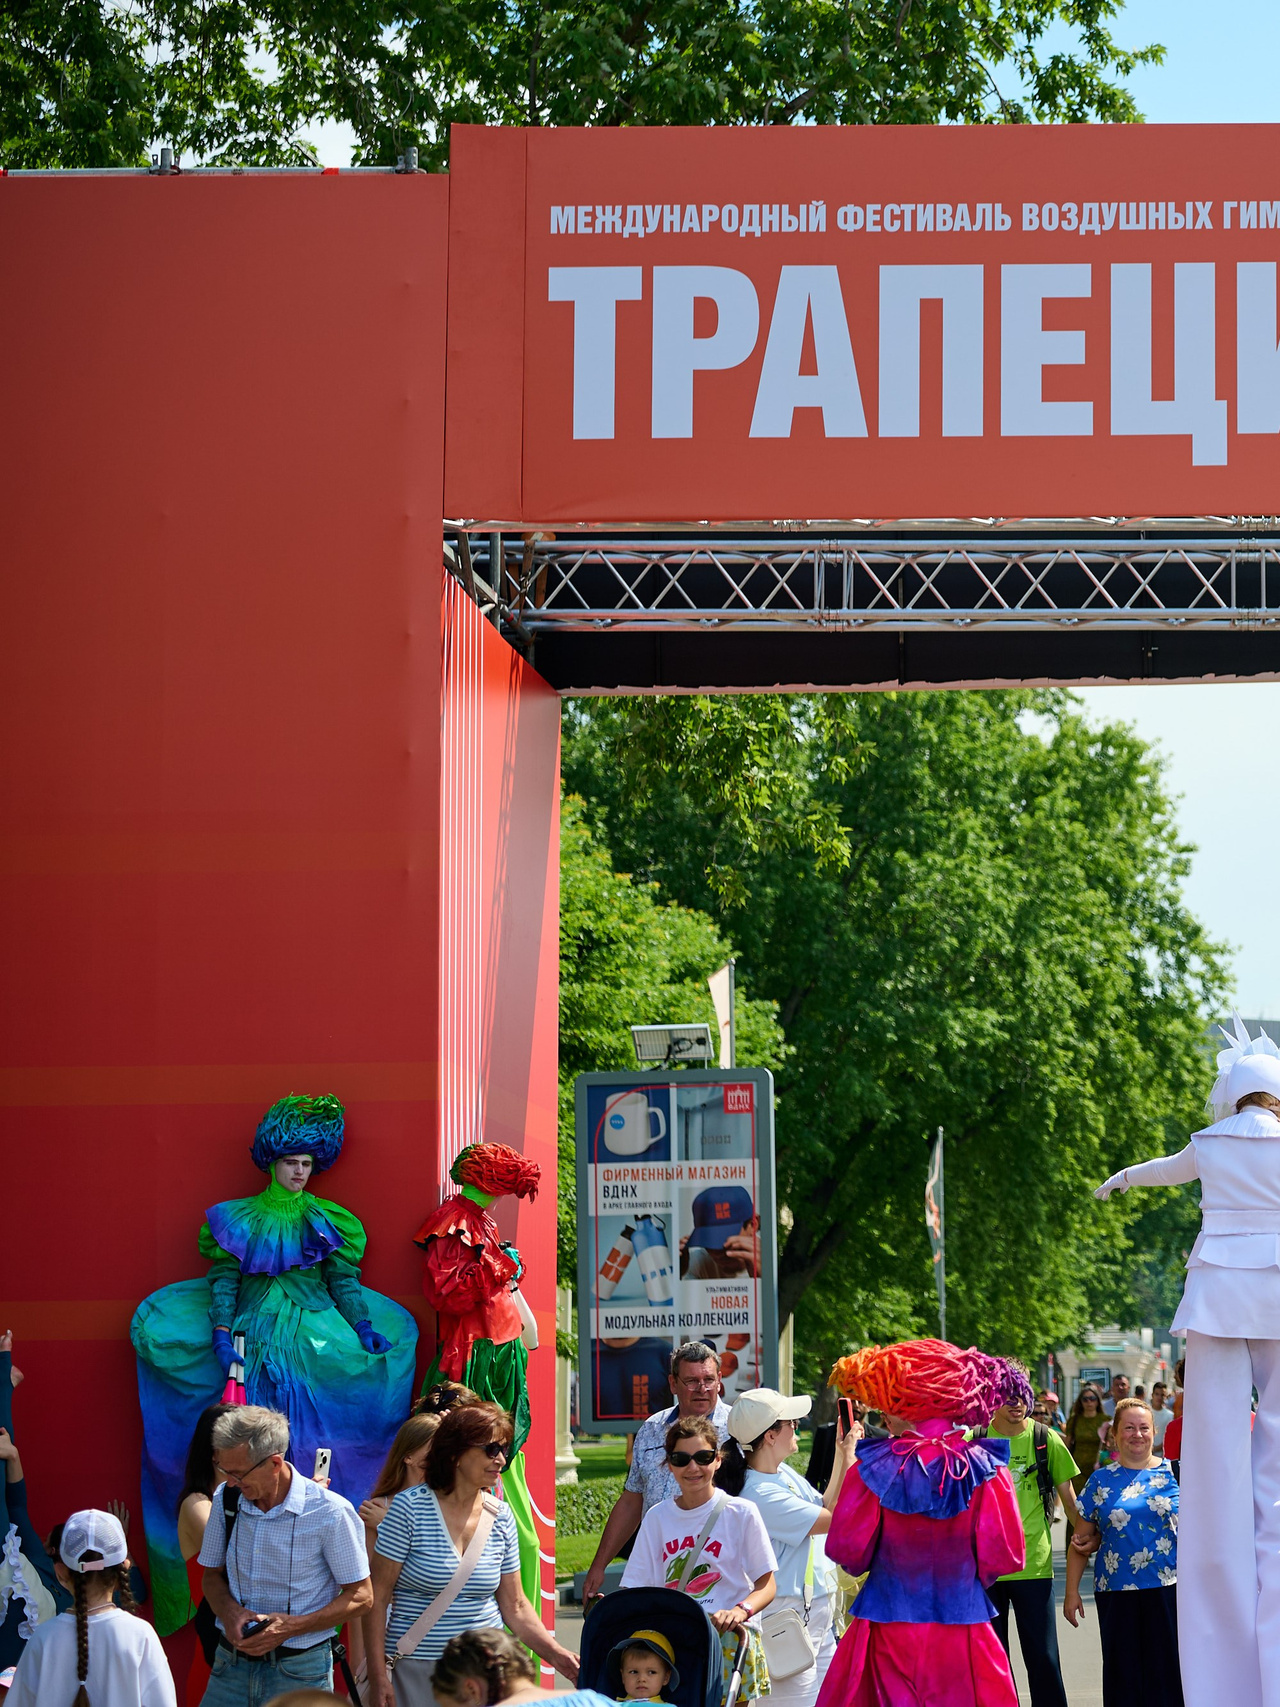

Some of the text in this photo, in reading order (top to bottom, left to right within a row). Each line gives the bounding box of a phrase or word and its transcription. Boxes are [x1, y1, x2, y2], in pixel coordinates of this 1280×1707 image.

[550, 200, 827, 239] МЕЖДУНАРОДНЫЙ
[836, 201, 1012, 233] ФЕСТИВАЛЬ
[1022, 200, 1214, 236] ВОЗДУШНЫХ
[603, 1165, 746, 1182] ФИРМЕННЫЙ МАГАЗИН
[603, 1185, 638, 1200] ВДНХ
[711, 1295, 749, 1310] НОВАЯ
[604, 1311, 749, 1331] МОДУЛЬНАЯ КОЛЛЕКЦИЯ
[663, 1534, 723, 1563] UAA
